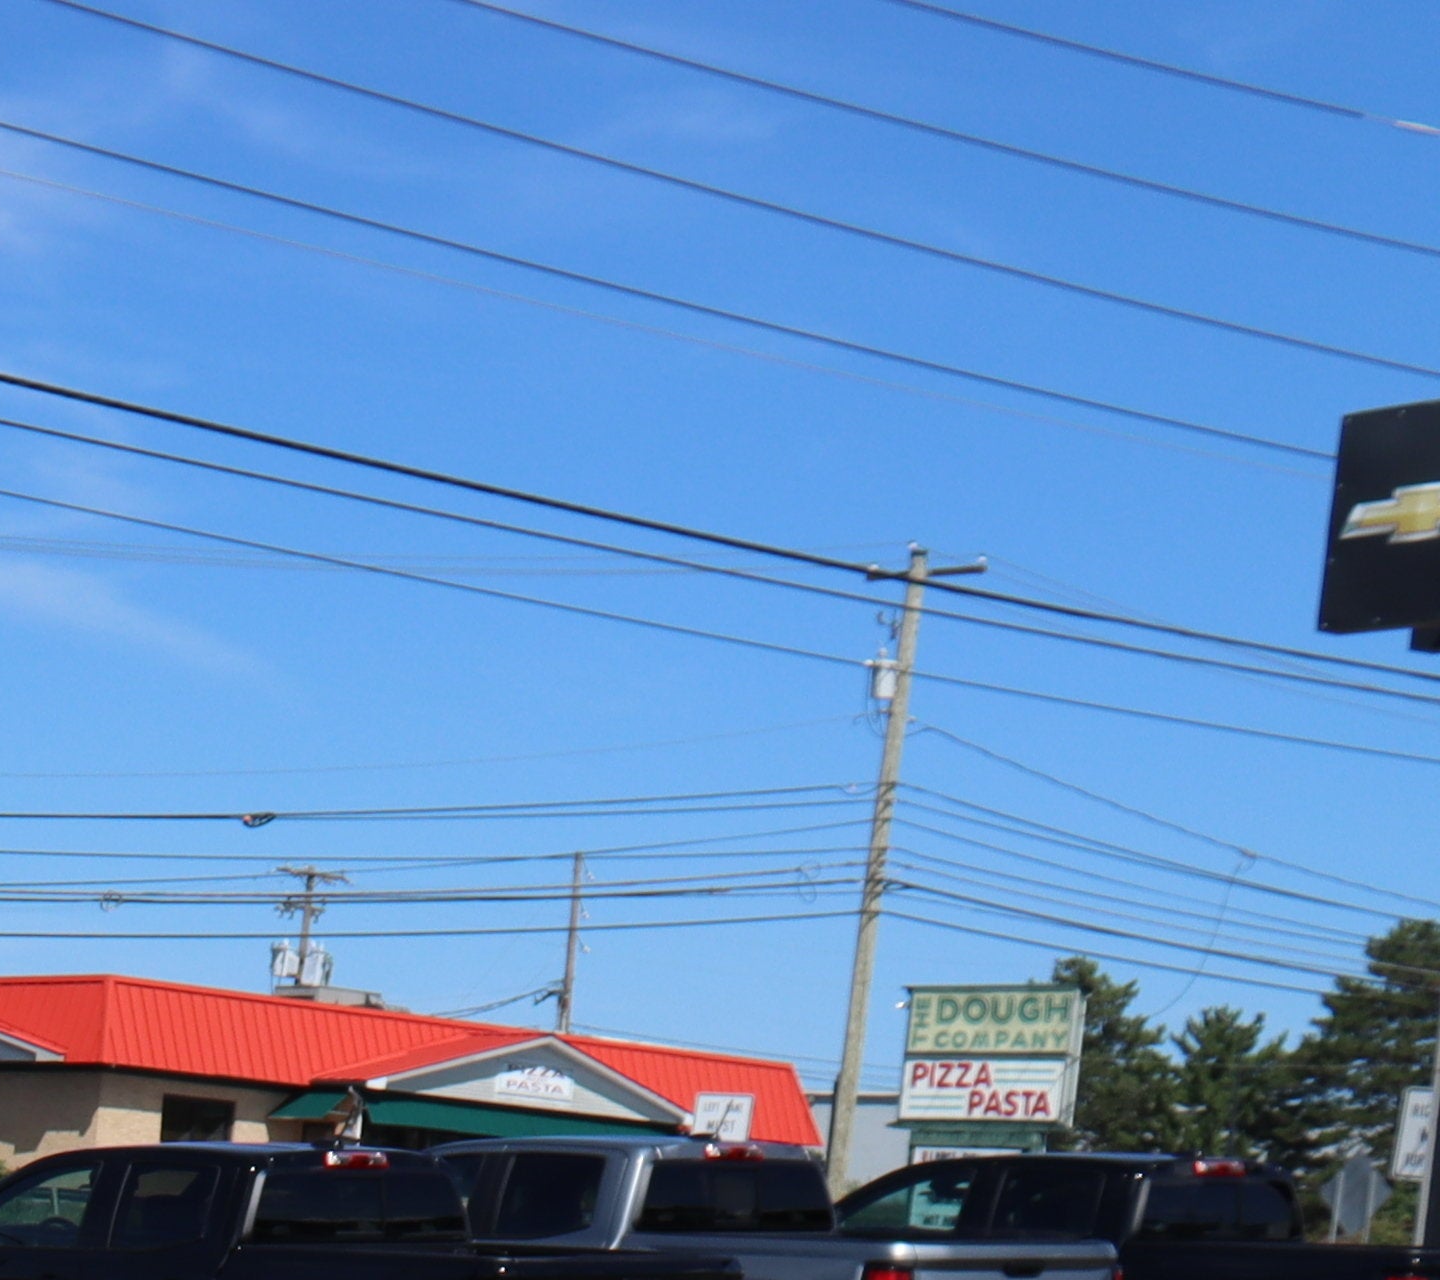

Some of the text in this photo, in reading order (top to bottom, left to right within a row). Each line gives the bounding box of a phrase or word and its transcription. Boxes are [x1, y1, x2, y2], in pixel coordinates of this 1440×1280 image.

[911, 996, 930, 1048] THE
[935, 994, 1072, 1025] DOUGH
[933, 1030, 1069, 1049] COMPANY
[506, 1080, 564, 1094] PASTA
[910, 1061, 994, 1089] PIZZA
[966, 1090, 1051, 1117] PASTA
